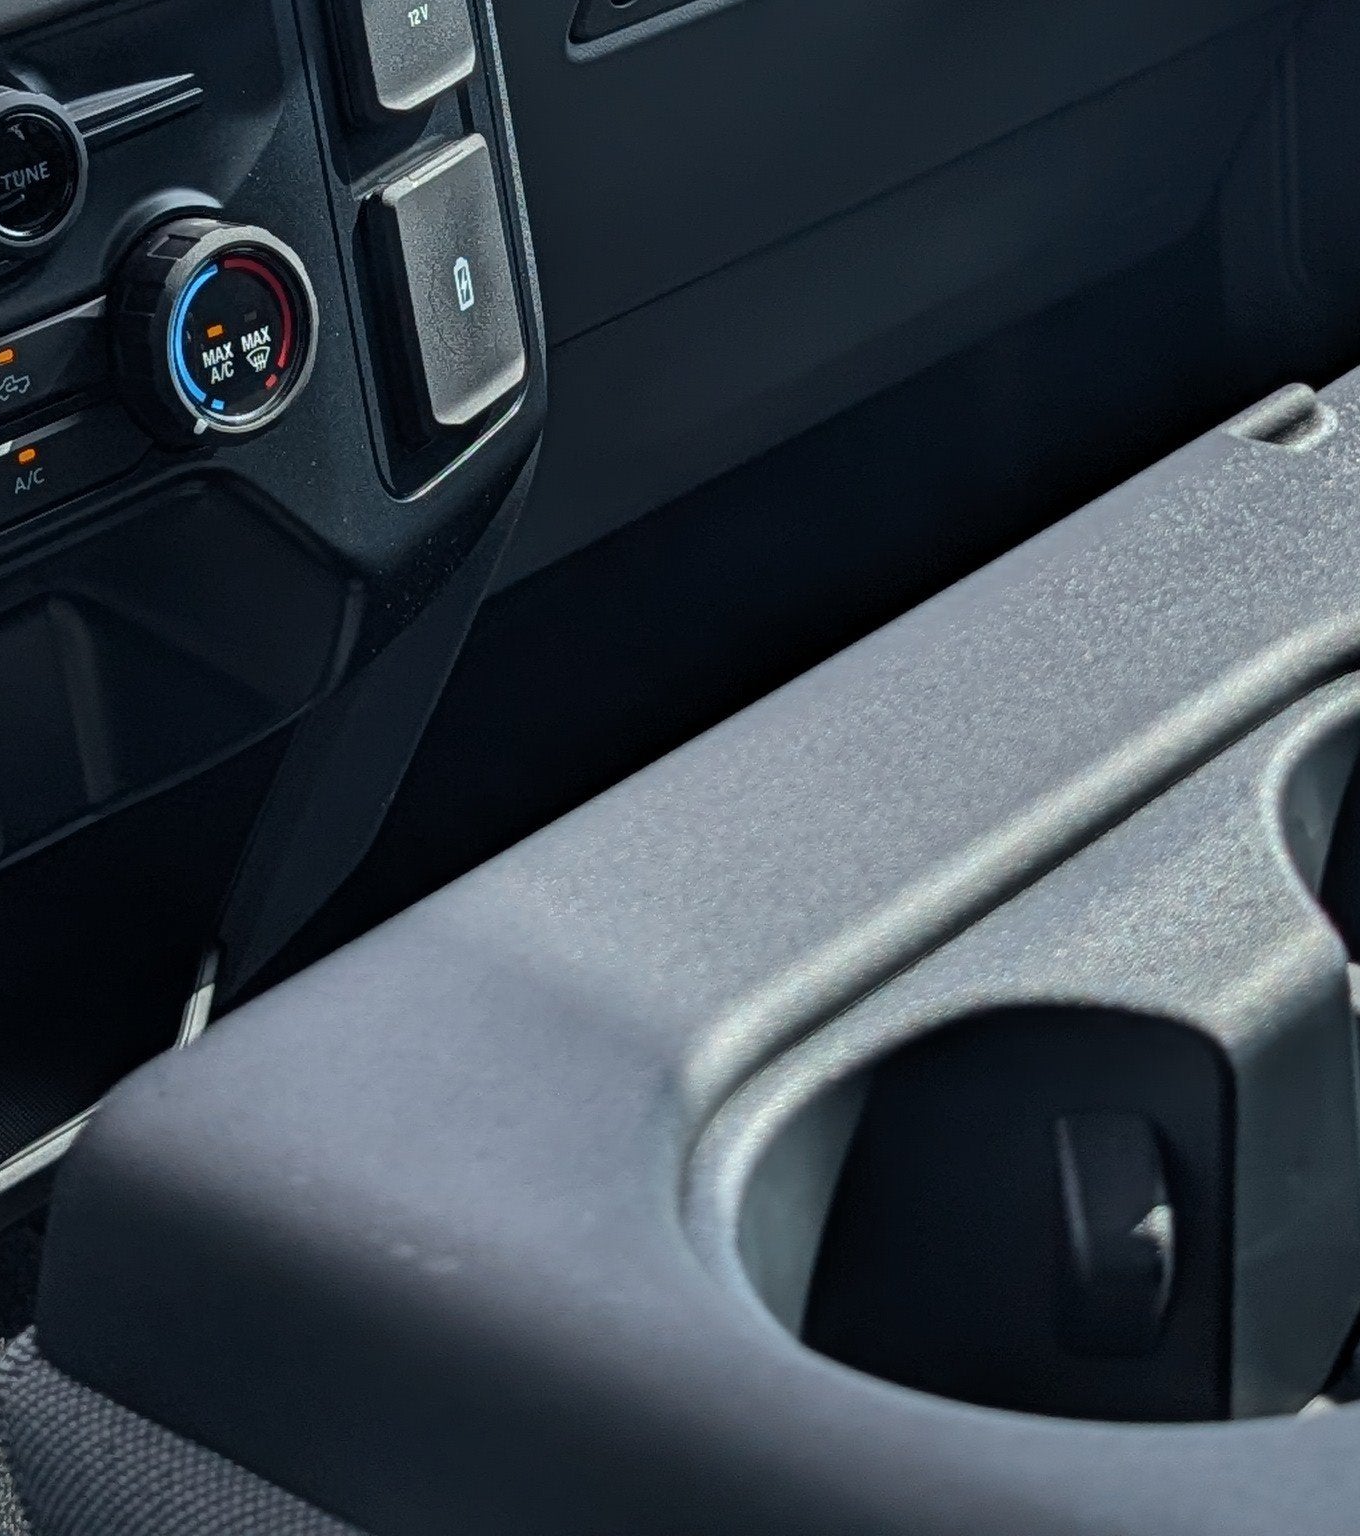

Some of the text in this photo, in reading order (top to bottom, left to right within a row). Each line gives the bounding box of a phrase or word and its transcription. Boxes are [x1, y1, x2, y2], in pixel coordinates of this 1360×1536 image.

[0, 161, 50, 190] TUNE
[241, 325, 271, 352] MAX
[202, 342, 235, 368] MAX
[210, 361, 236, 385] A/C
[14, 467, 45, 494] A/C
